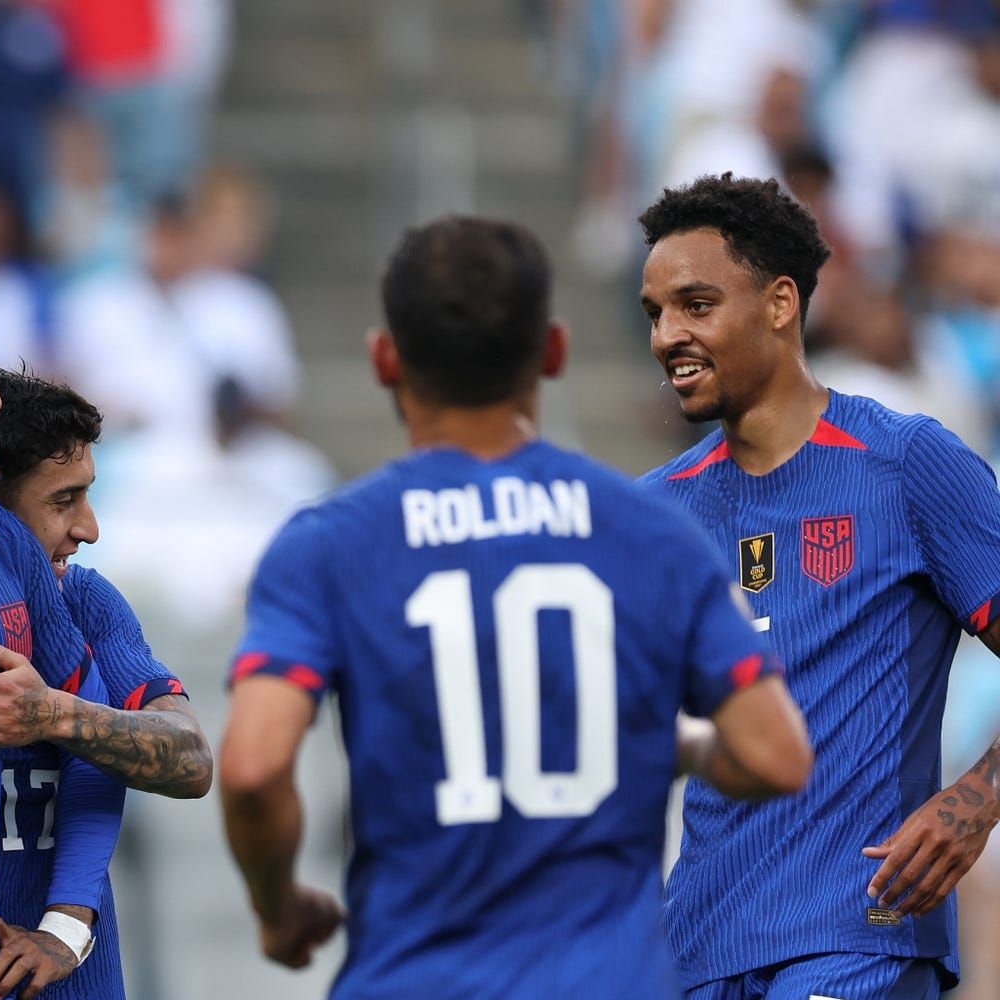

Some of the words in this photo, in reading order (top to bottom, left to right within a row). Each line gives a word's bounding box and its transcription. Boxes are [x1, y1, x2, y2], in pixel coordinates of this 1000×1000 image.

[402, 477, 592, 549] ROLDAN
[806, 520, 849, 548] USA
[0, 606, 28, 636] USA
[404, 562, 619, 827] 10
[1, 768, 60, 851] 17
